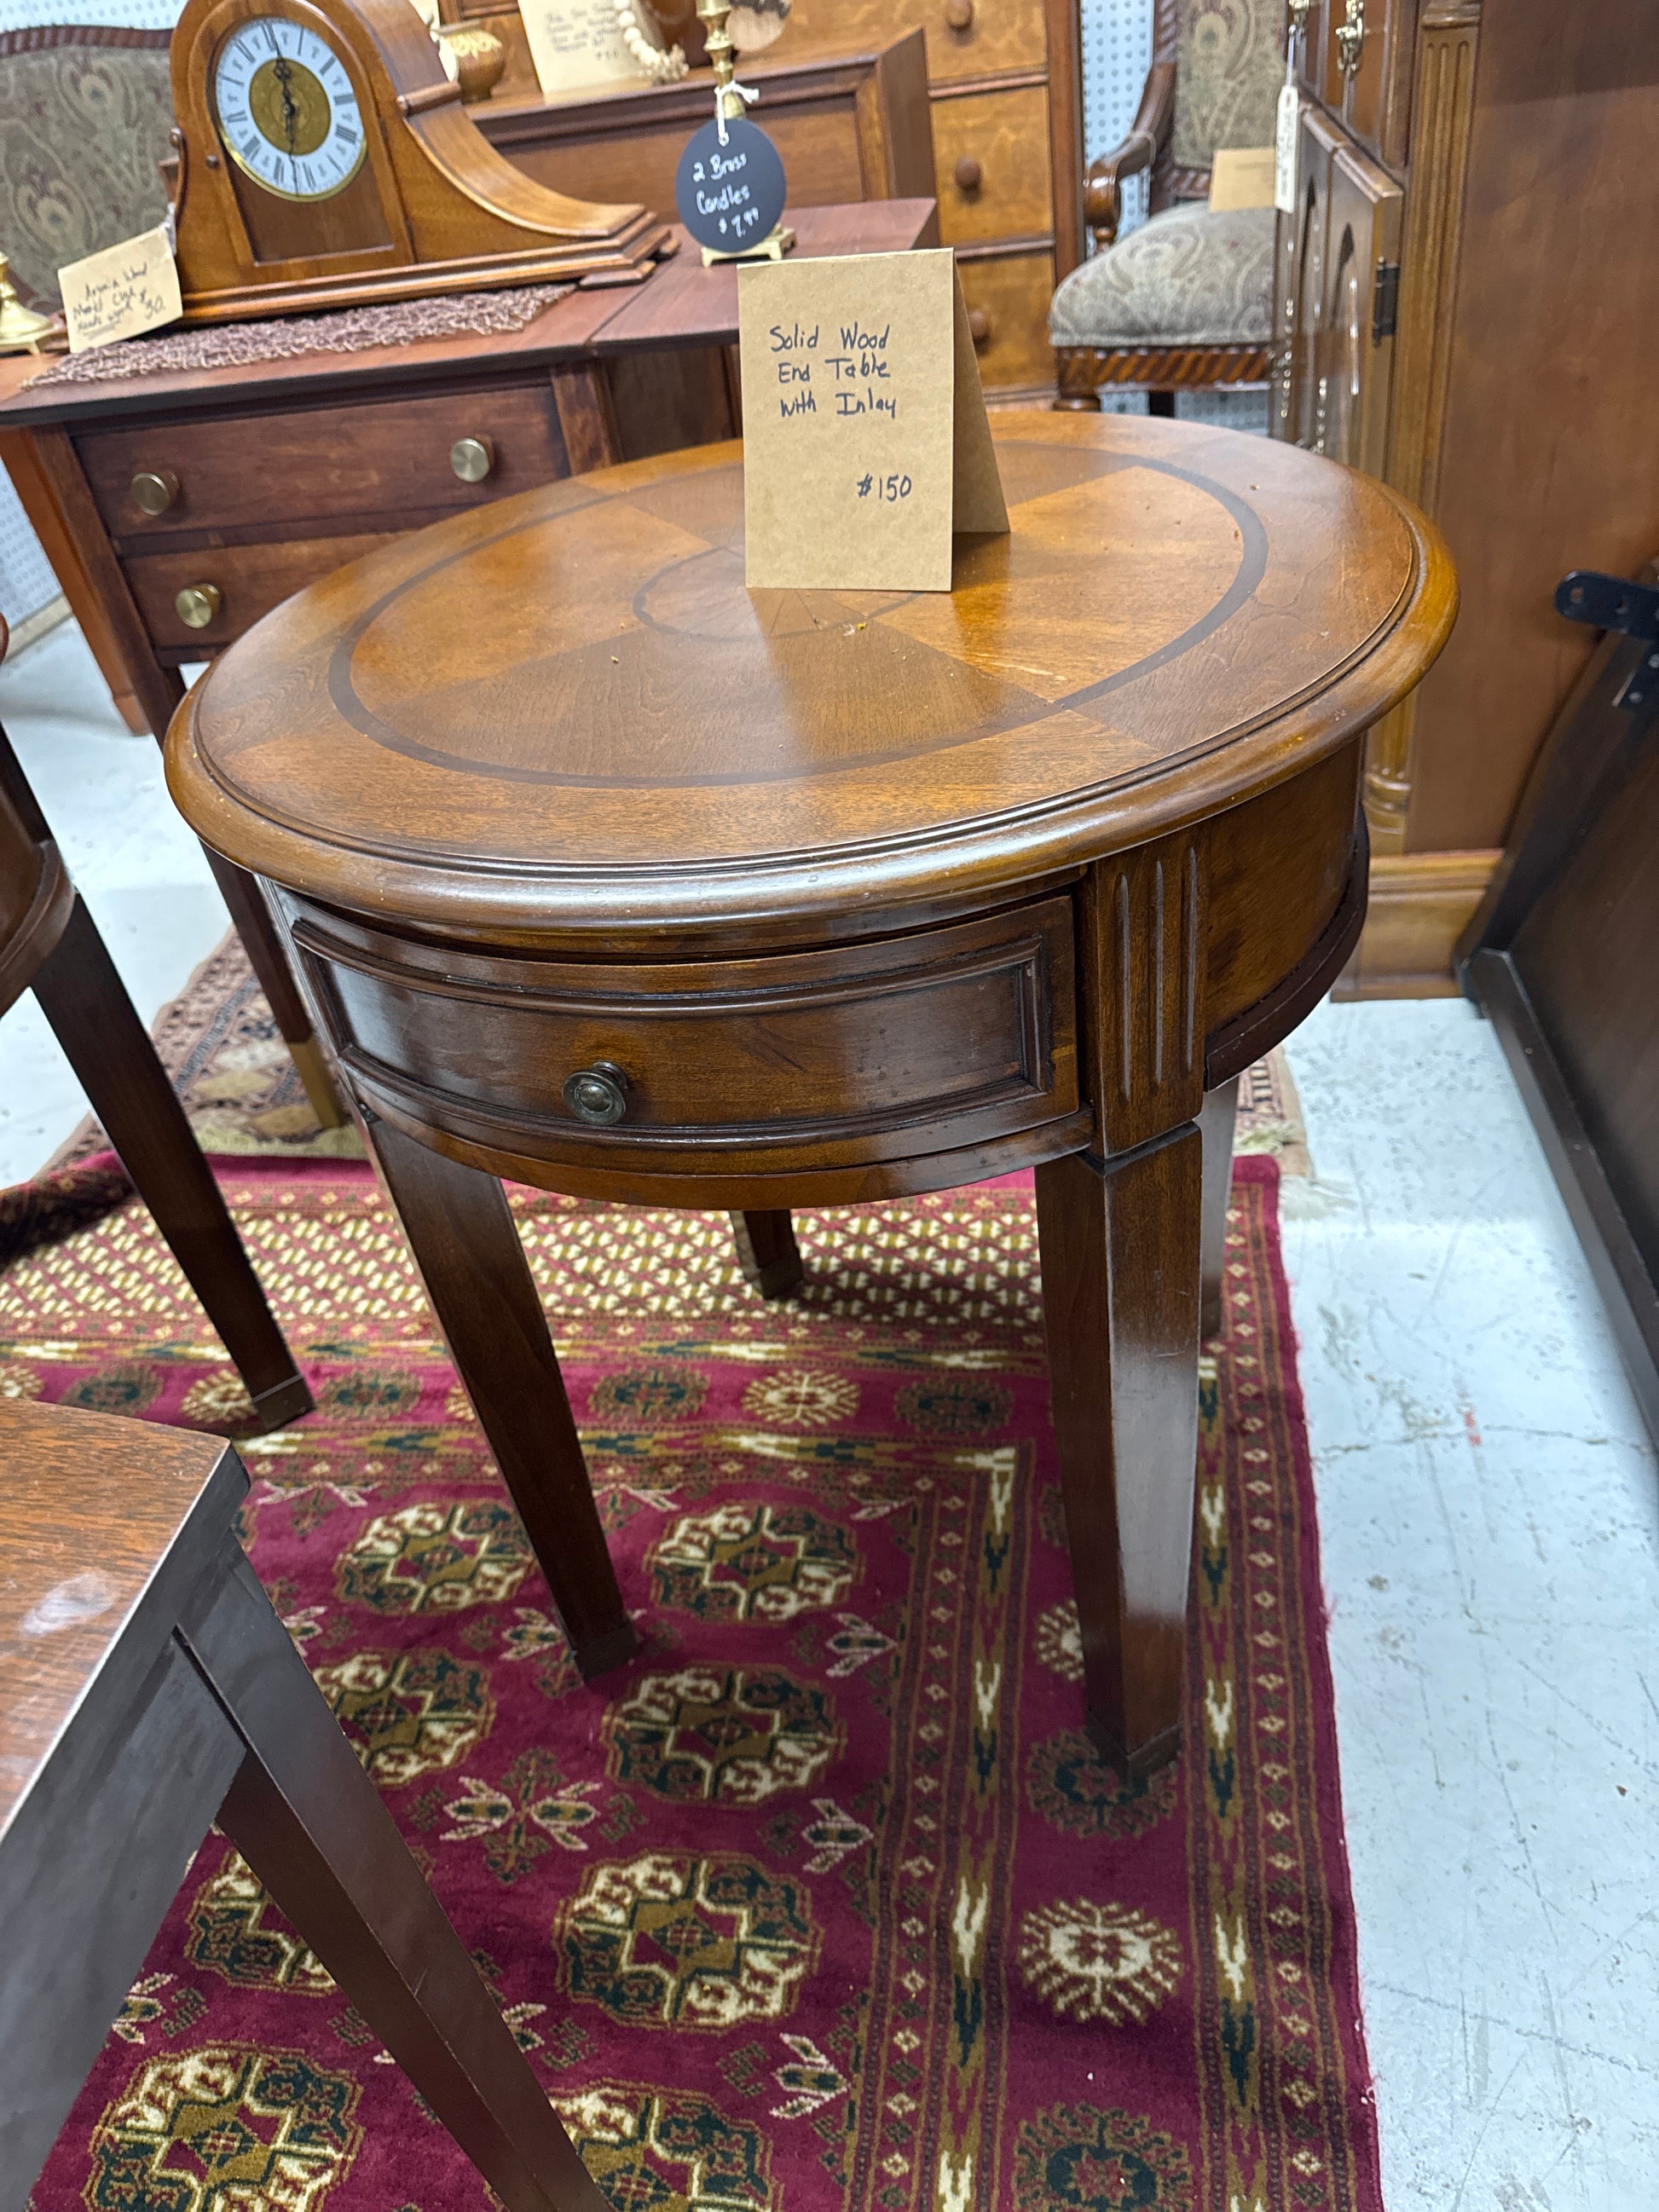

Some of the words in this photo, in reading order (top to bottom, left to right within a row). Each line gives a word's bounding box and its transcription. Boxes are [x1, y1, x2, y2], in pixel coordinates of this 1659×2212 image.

[693, 162, 705, 182] 2
[709, 153, 747, 180] Brass
[769, 322, 819, 352] Solid
[840, 321, 890, 350] Wood
[777, 362, 811, 384] End
[824, 351, 891, 380] Table
[780, 390, 817, 418] with
[835, 387, 897, 419] Inlay
[857, 473, 912, 502] $150
